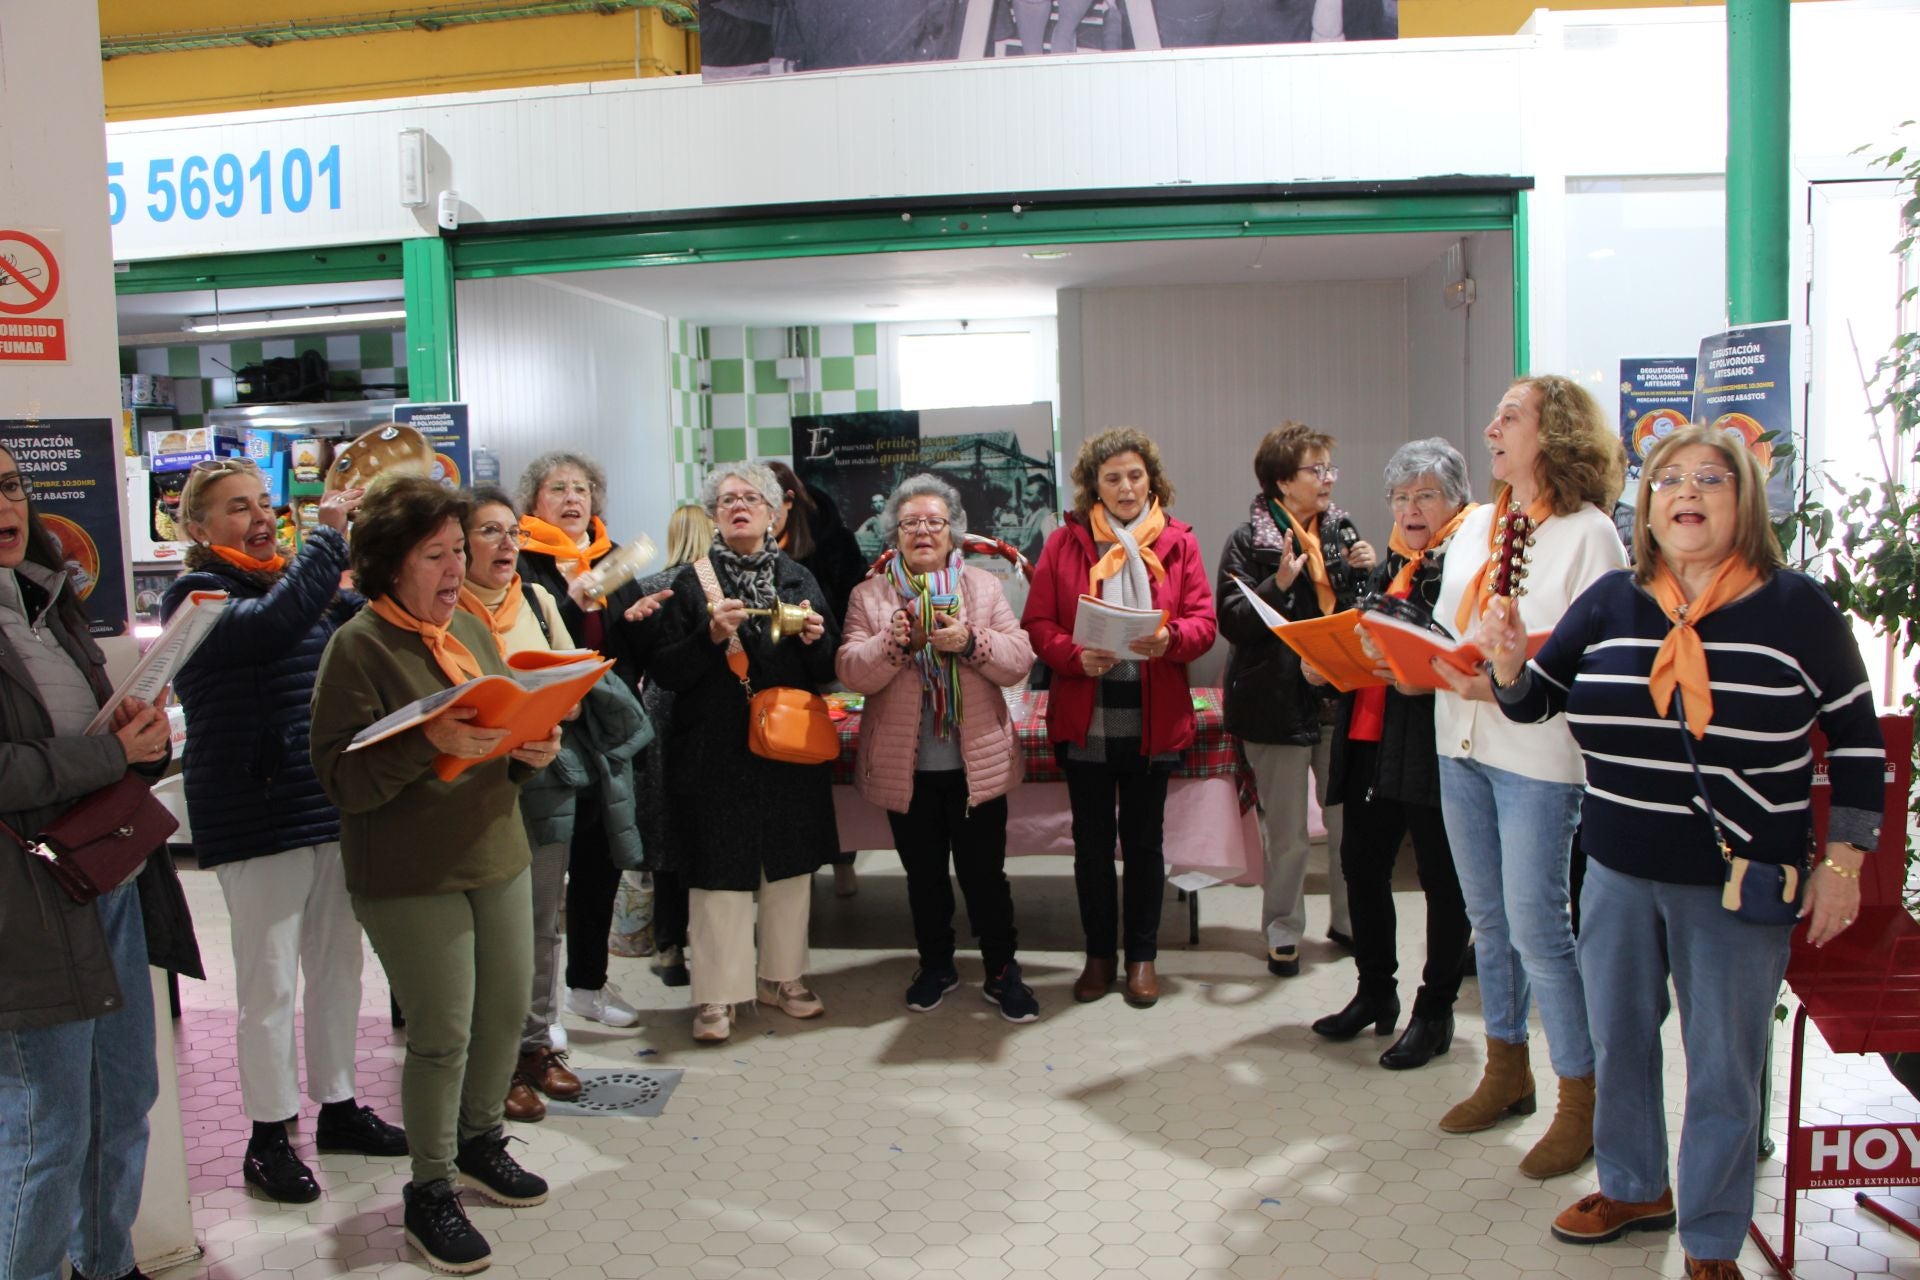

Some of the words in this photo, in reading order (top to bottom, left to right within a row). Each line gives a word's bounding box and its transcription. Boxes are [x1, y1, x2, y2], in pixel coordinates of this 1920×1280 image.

[147, 144, 341, 222] 569101
[0, 324, 57, 338] OHIBIDO
[1712, 342, 1760, 357] DEGUSTACIÓN
[1716, 354, 1765, 367] POLVORONES
[1714, 366, 1754, 378] ARTESANOS
[1735, 392, 1766, 402] ABASTOS
[44, 490, 86, 500] ABASTOS
[1811, 1128, 1920, 1172] HOY
[1810, 1179, 1845, 1187] DIARIO
[1864, 1176, 1920, 1185] EXTREMAD
